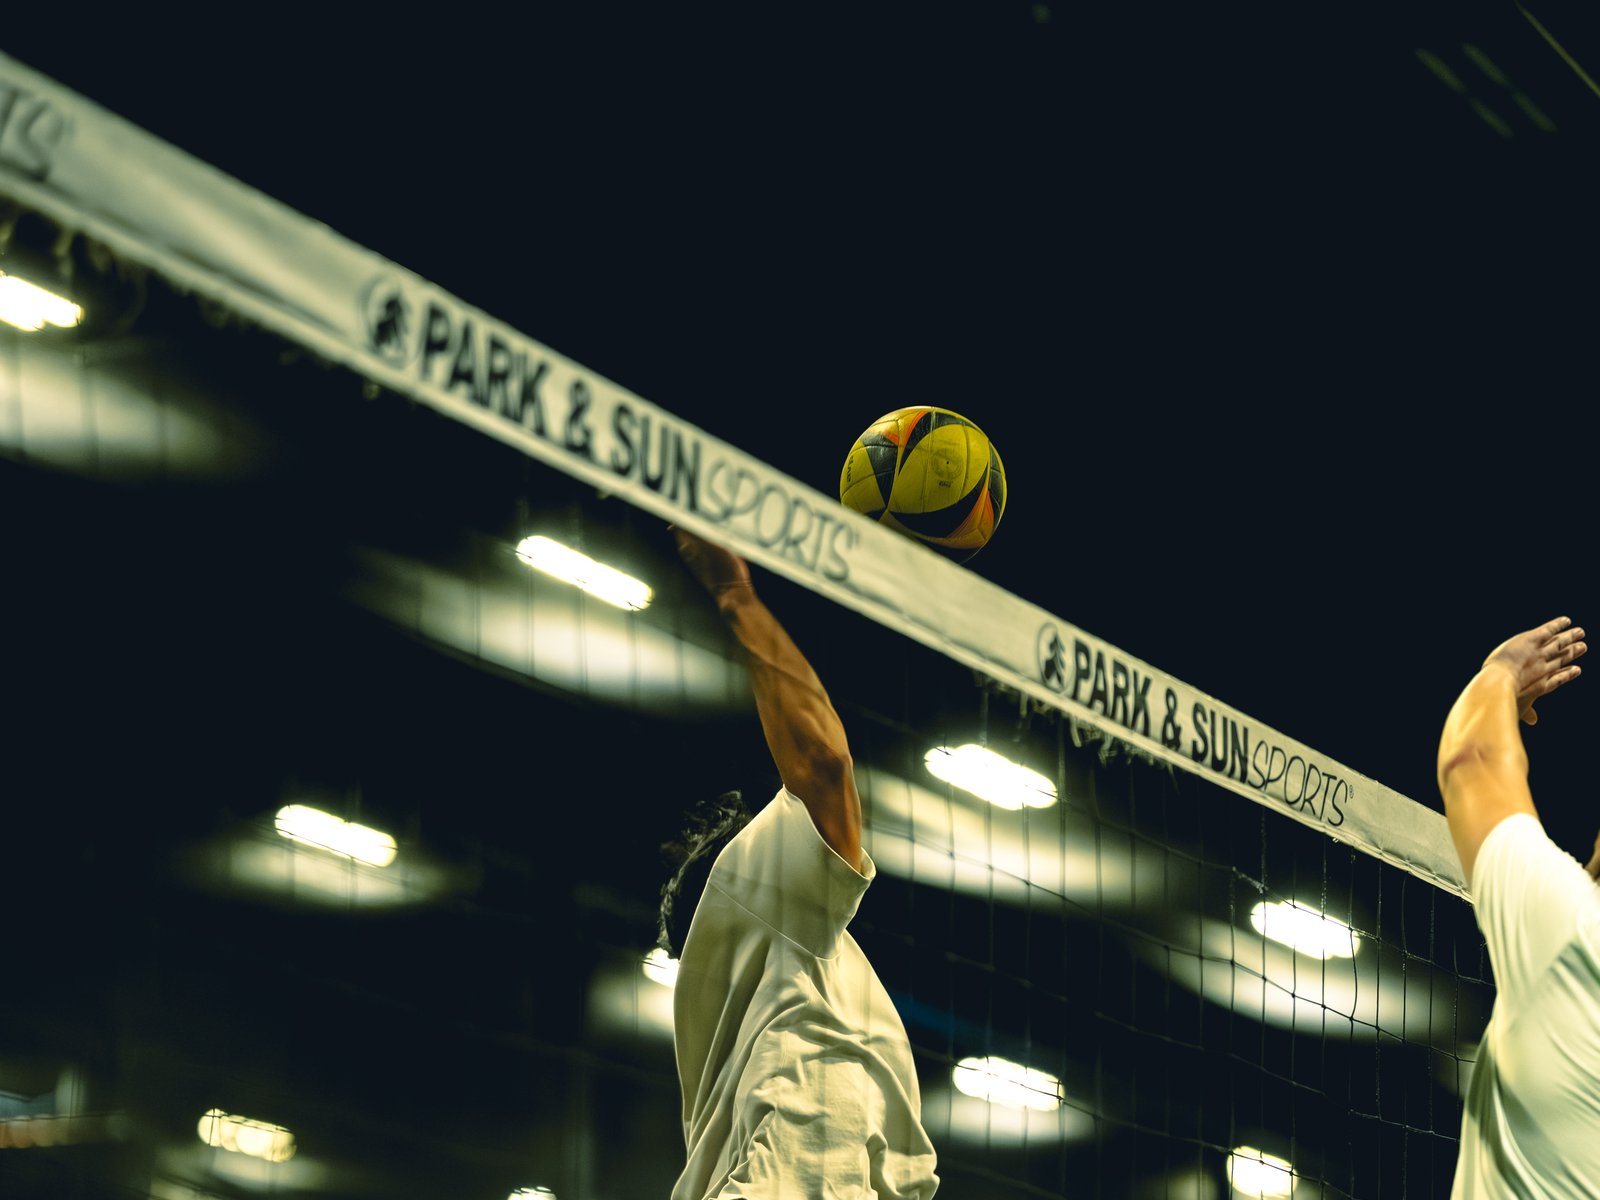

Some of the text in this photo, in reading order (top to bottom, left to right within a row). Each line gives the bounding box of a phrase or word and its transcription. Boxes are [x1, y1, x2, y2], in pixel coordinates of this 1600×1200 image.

[420, 304, 549, 440] PARK
[563, 379, 596, 461] &
[1072, 637, 1154, 738] PARK
[1161, 687, 1182, 751] &
